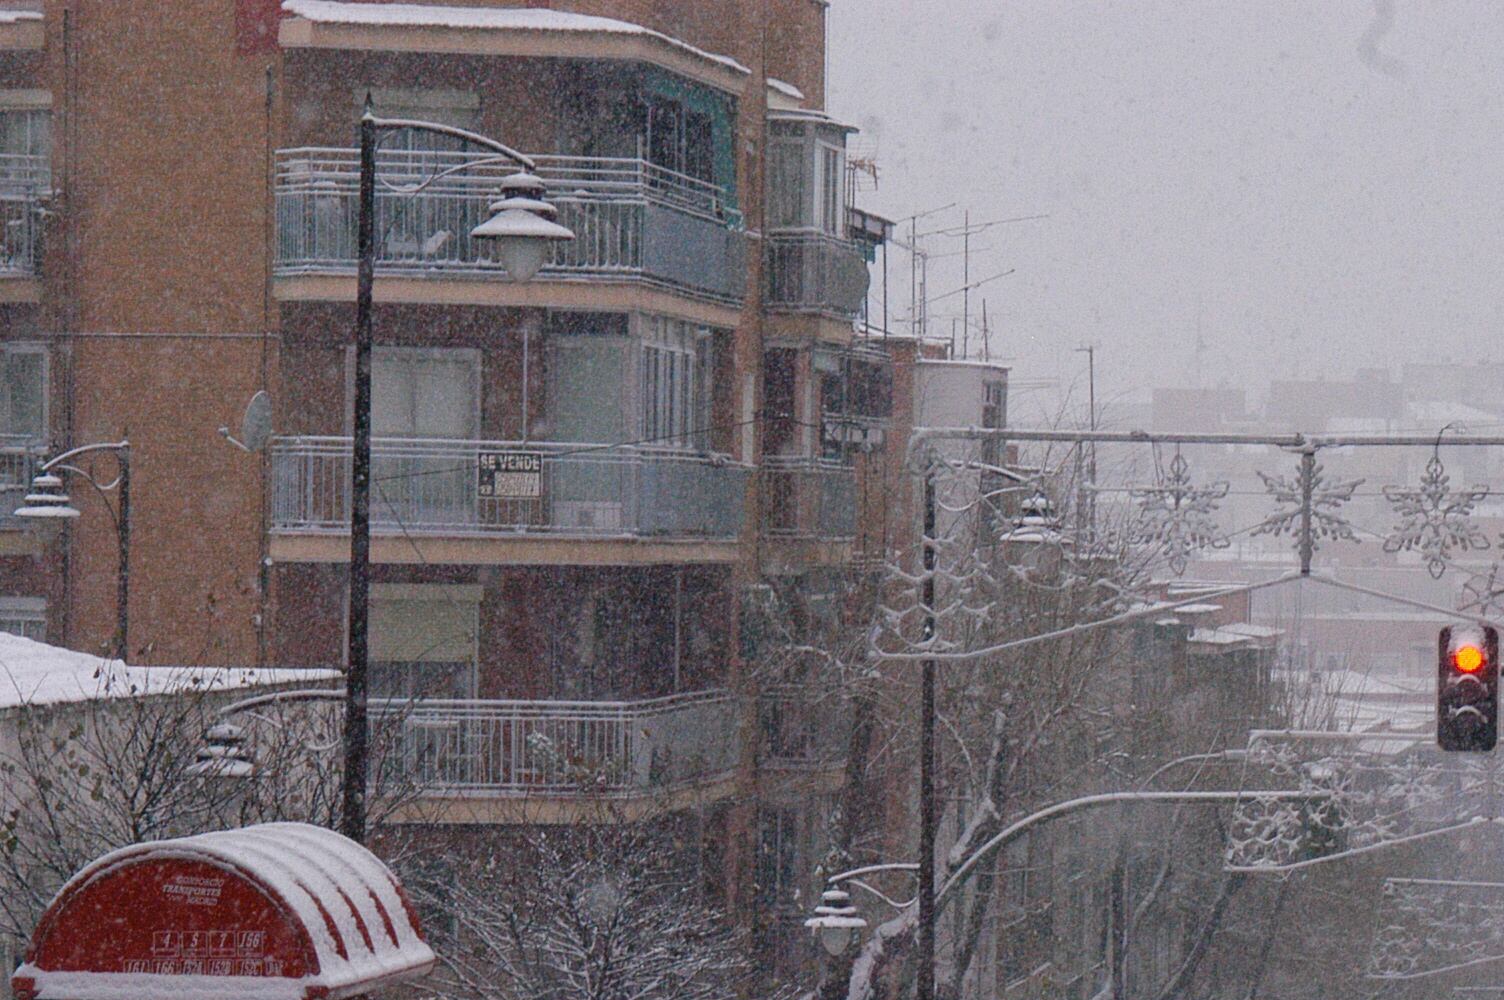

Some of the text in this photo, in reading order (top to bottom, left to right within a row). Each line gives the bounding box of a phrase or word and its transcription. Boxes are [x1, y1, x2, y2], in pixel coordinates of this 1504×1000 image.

[480, 455, 540, 470] SE VENDE
[163, 933, 172, 948] 4
[191, 933, 199, 948] 5
[219, 933, 228, 948] 7
